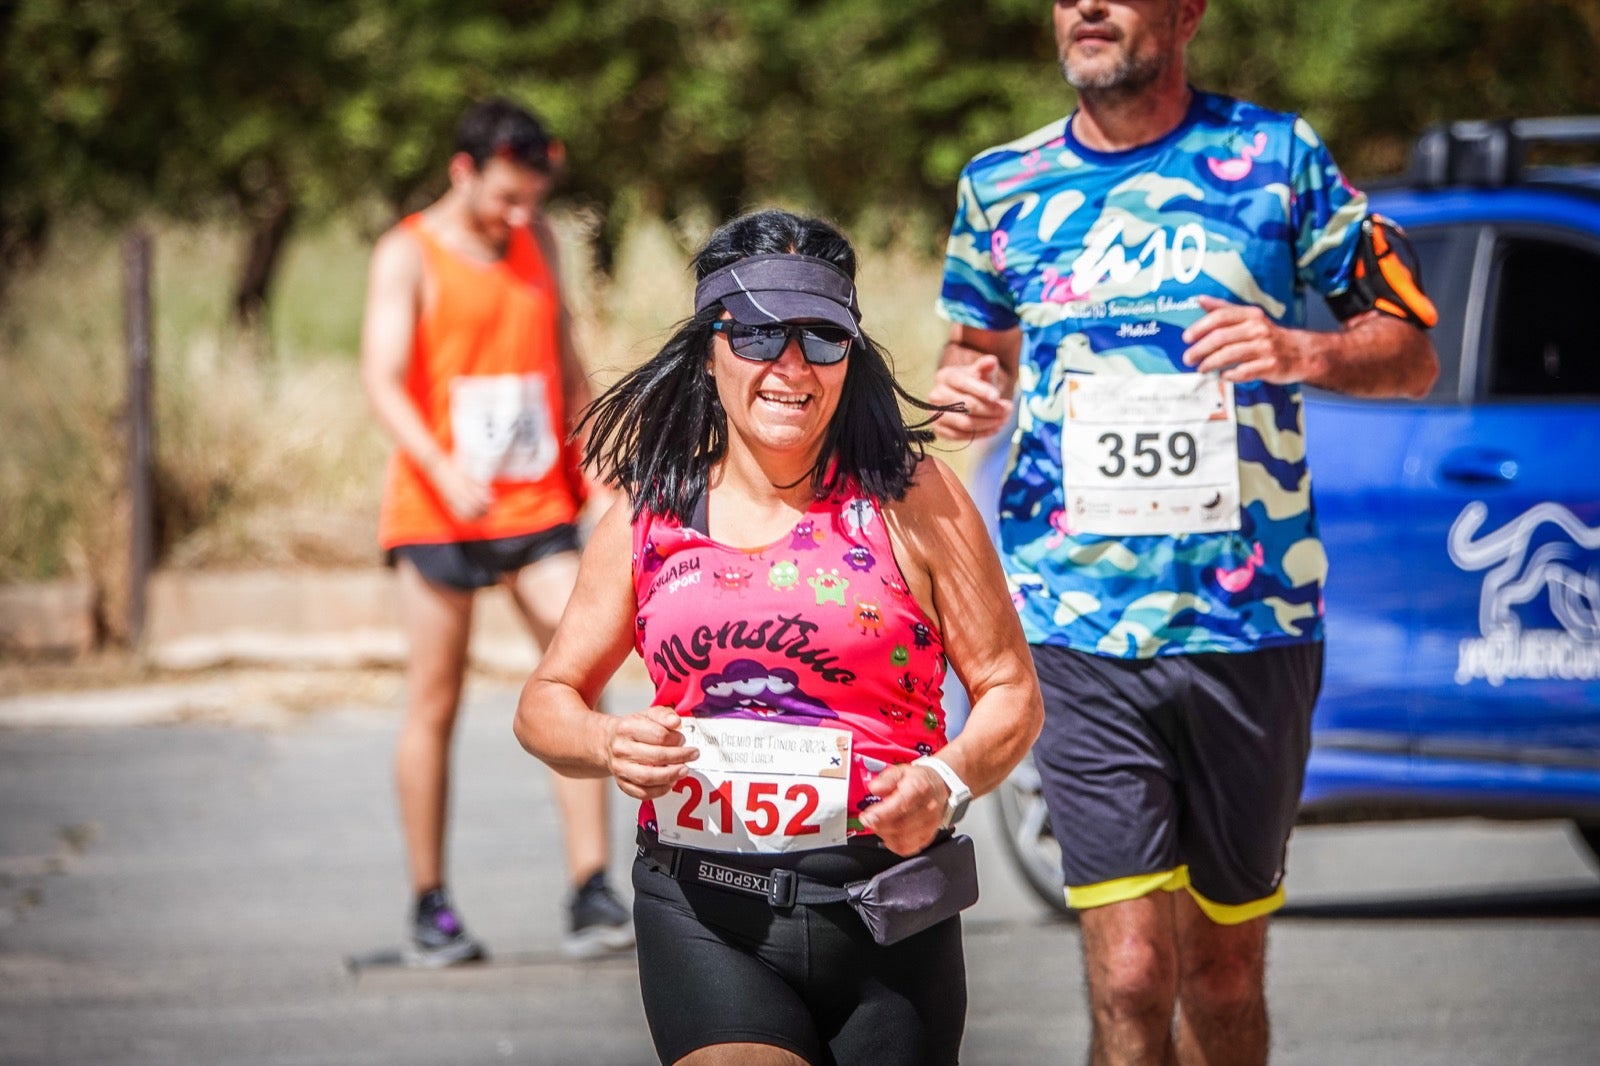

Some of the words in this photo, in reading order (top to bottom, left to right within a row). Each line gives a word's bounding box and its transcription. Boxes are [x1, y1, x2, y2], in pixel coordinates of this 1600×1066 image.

[1098, 431, 1197, 477] 359
[669, 571, 702, 594] SPORT
[672, 775, 821, 837] 2152
